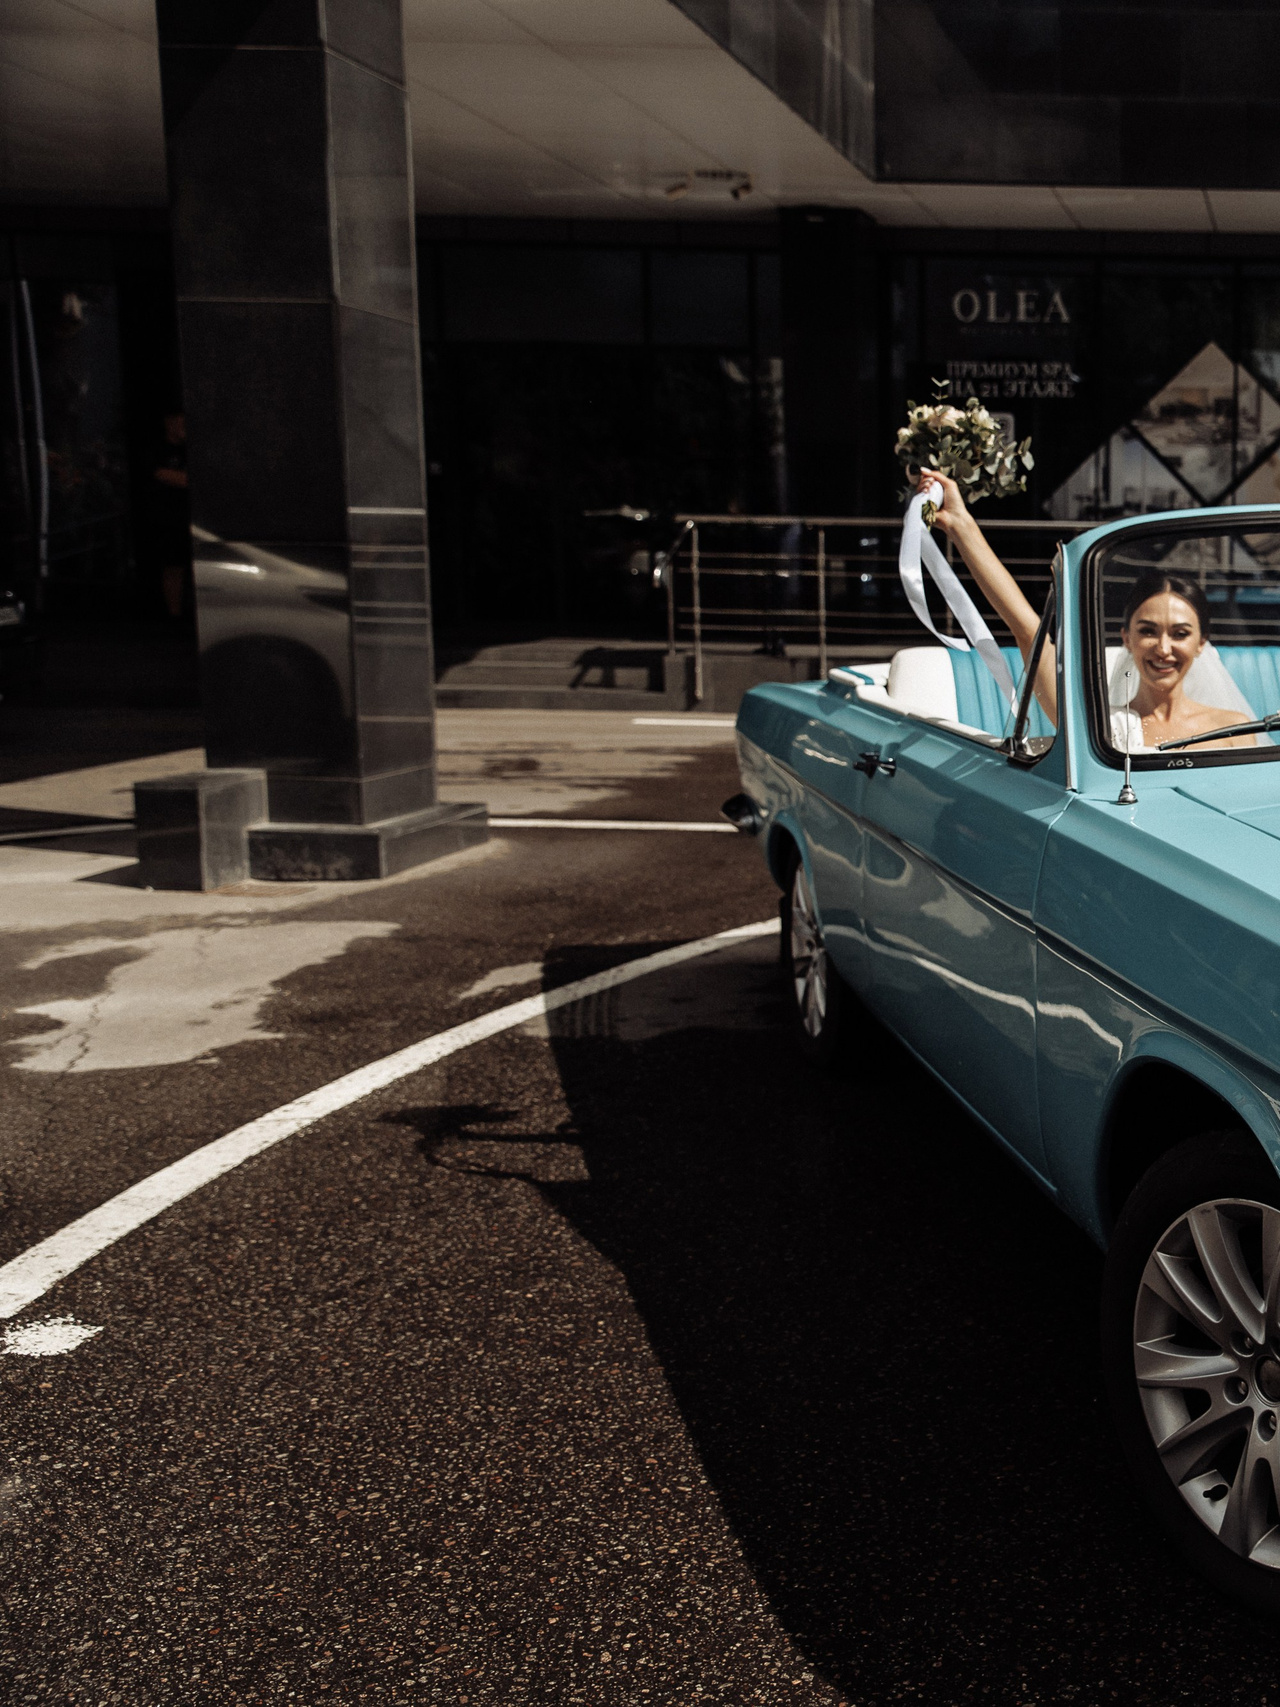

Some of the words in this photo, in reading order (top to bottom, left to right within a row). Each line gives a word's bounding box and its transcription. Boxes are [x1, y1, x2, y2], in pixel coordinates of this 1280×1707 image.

[952, 288, 1070, 324] OLEA
[947, 360, 1037, 378] ПРЕМИУМ
[1041, 360, 1074, 378] SPA
[947, 379, 976, 397] НА
[980, 383, 999, 398] 21
[1003, 379, 1075, 398] ЭТАЖЕ
